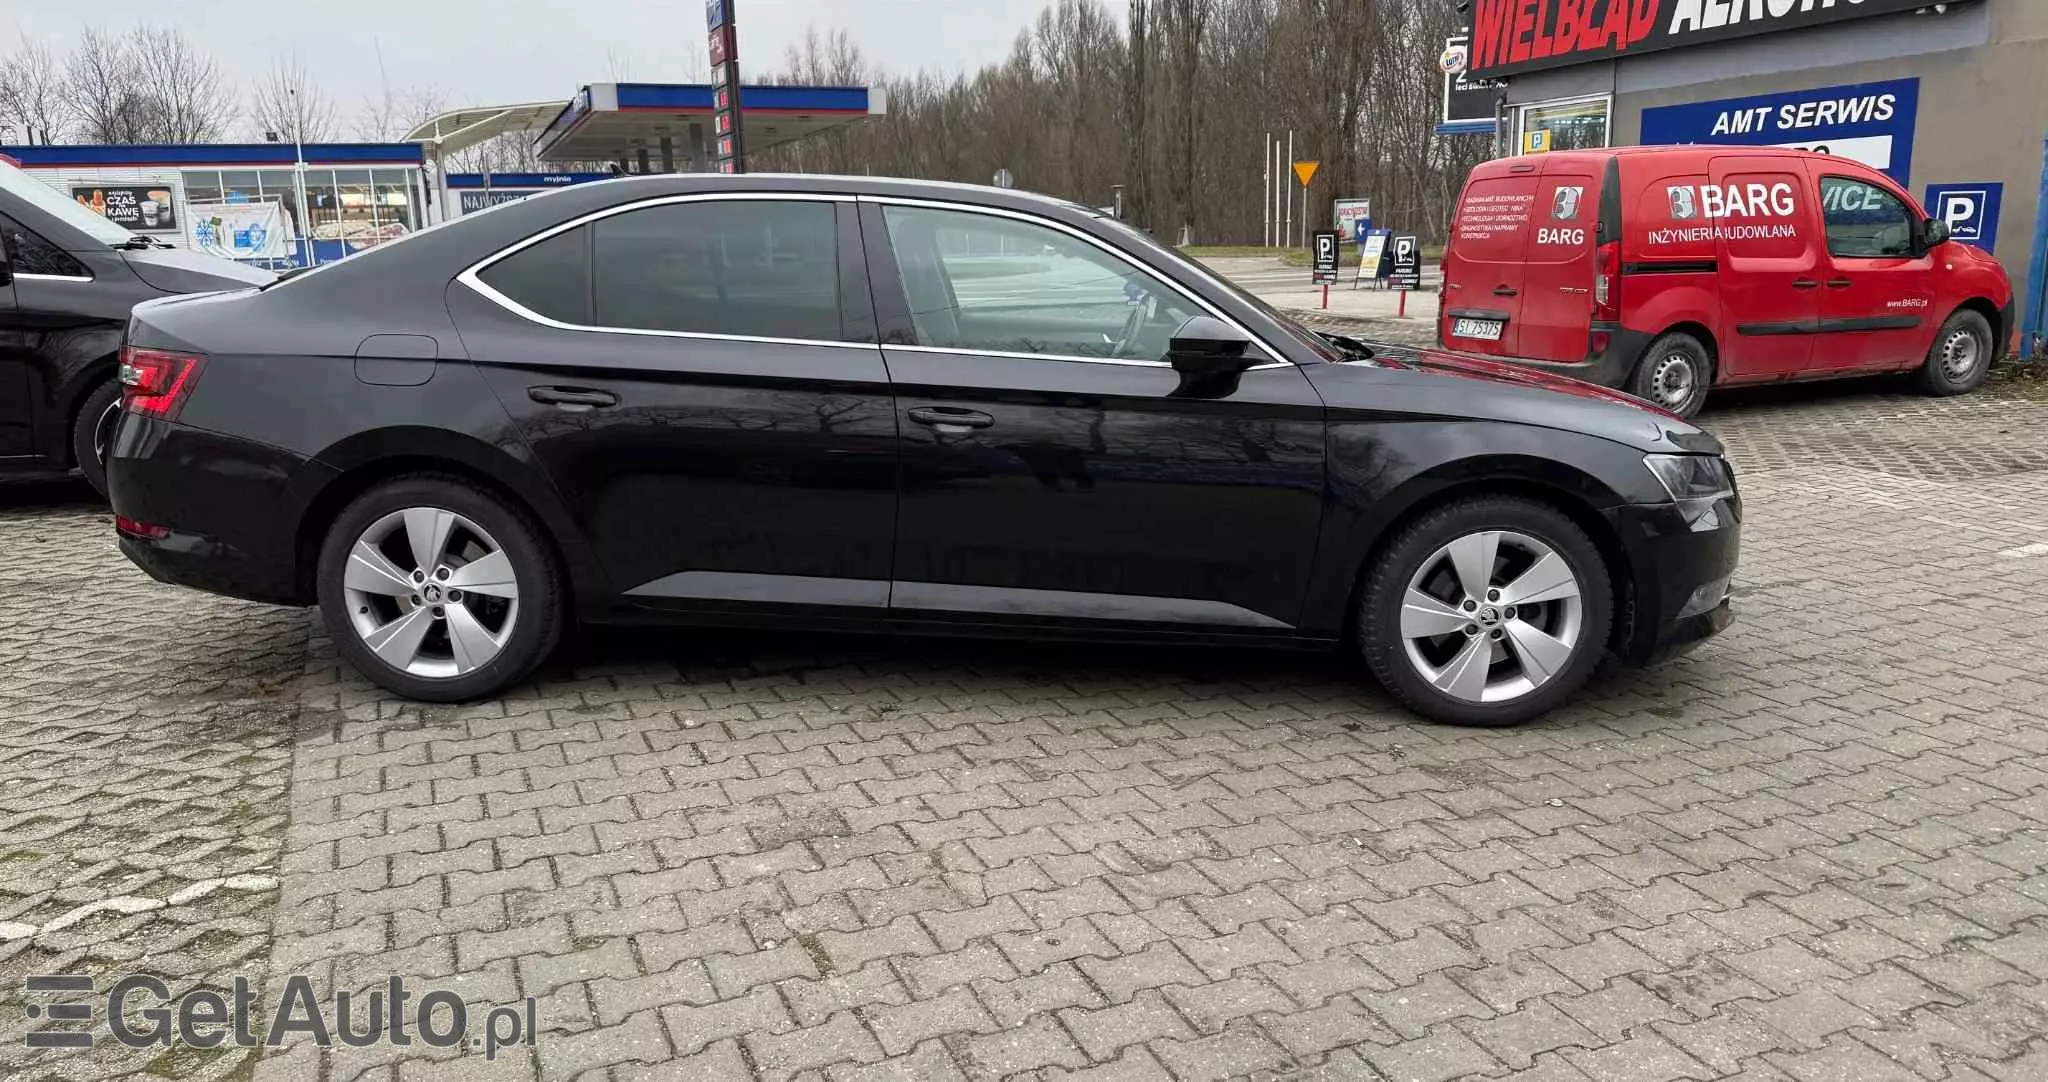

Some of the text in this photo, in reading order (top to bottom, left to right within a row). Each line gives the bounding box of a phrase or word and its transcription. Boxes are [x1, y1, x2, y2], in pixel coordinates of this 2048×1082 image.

[1711, 94, 1896, 136] AMT SERWIS
[106, 197, 136, 205] CZAS
[1700, 183, 1795, 217] BARG
[107, 208, 139, 217] KAWĘ
[1945, 198, 1975, 233] P
[1537, 228, 1584, 245] BARG
[1648, 226, 1723, 244] INŻYNIERIA
[1320, 238, 1330, 259] P
[1397, 240, 1410, 262] P
[1887, 298, 1928, 309] www.BARG.pl
